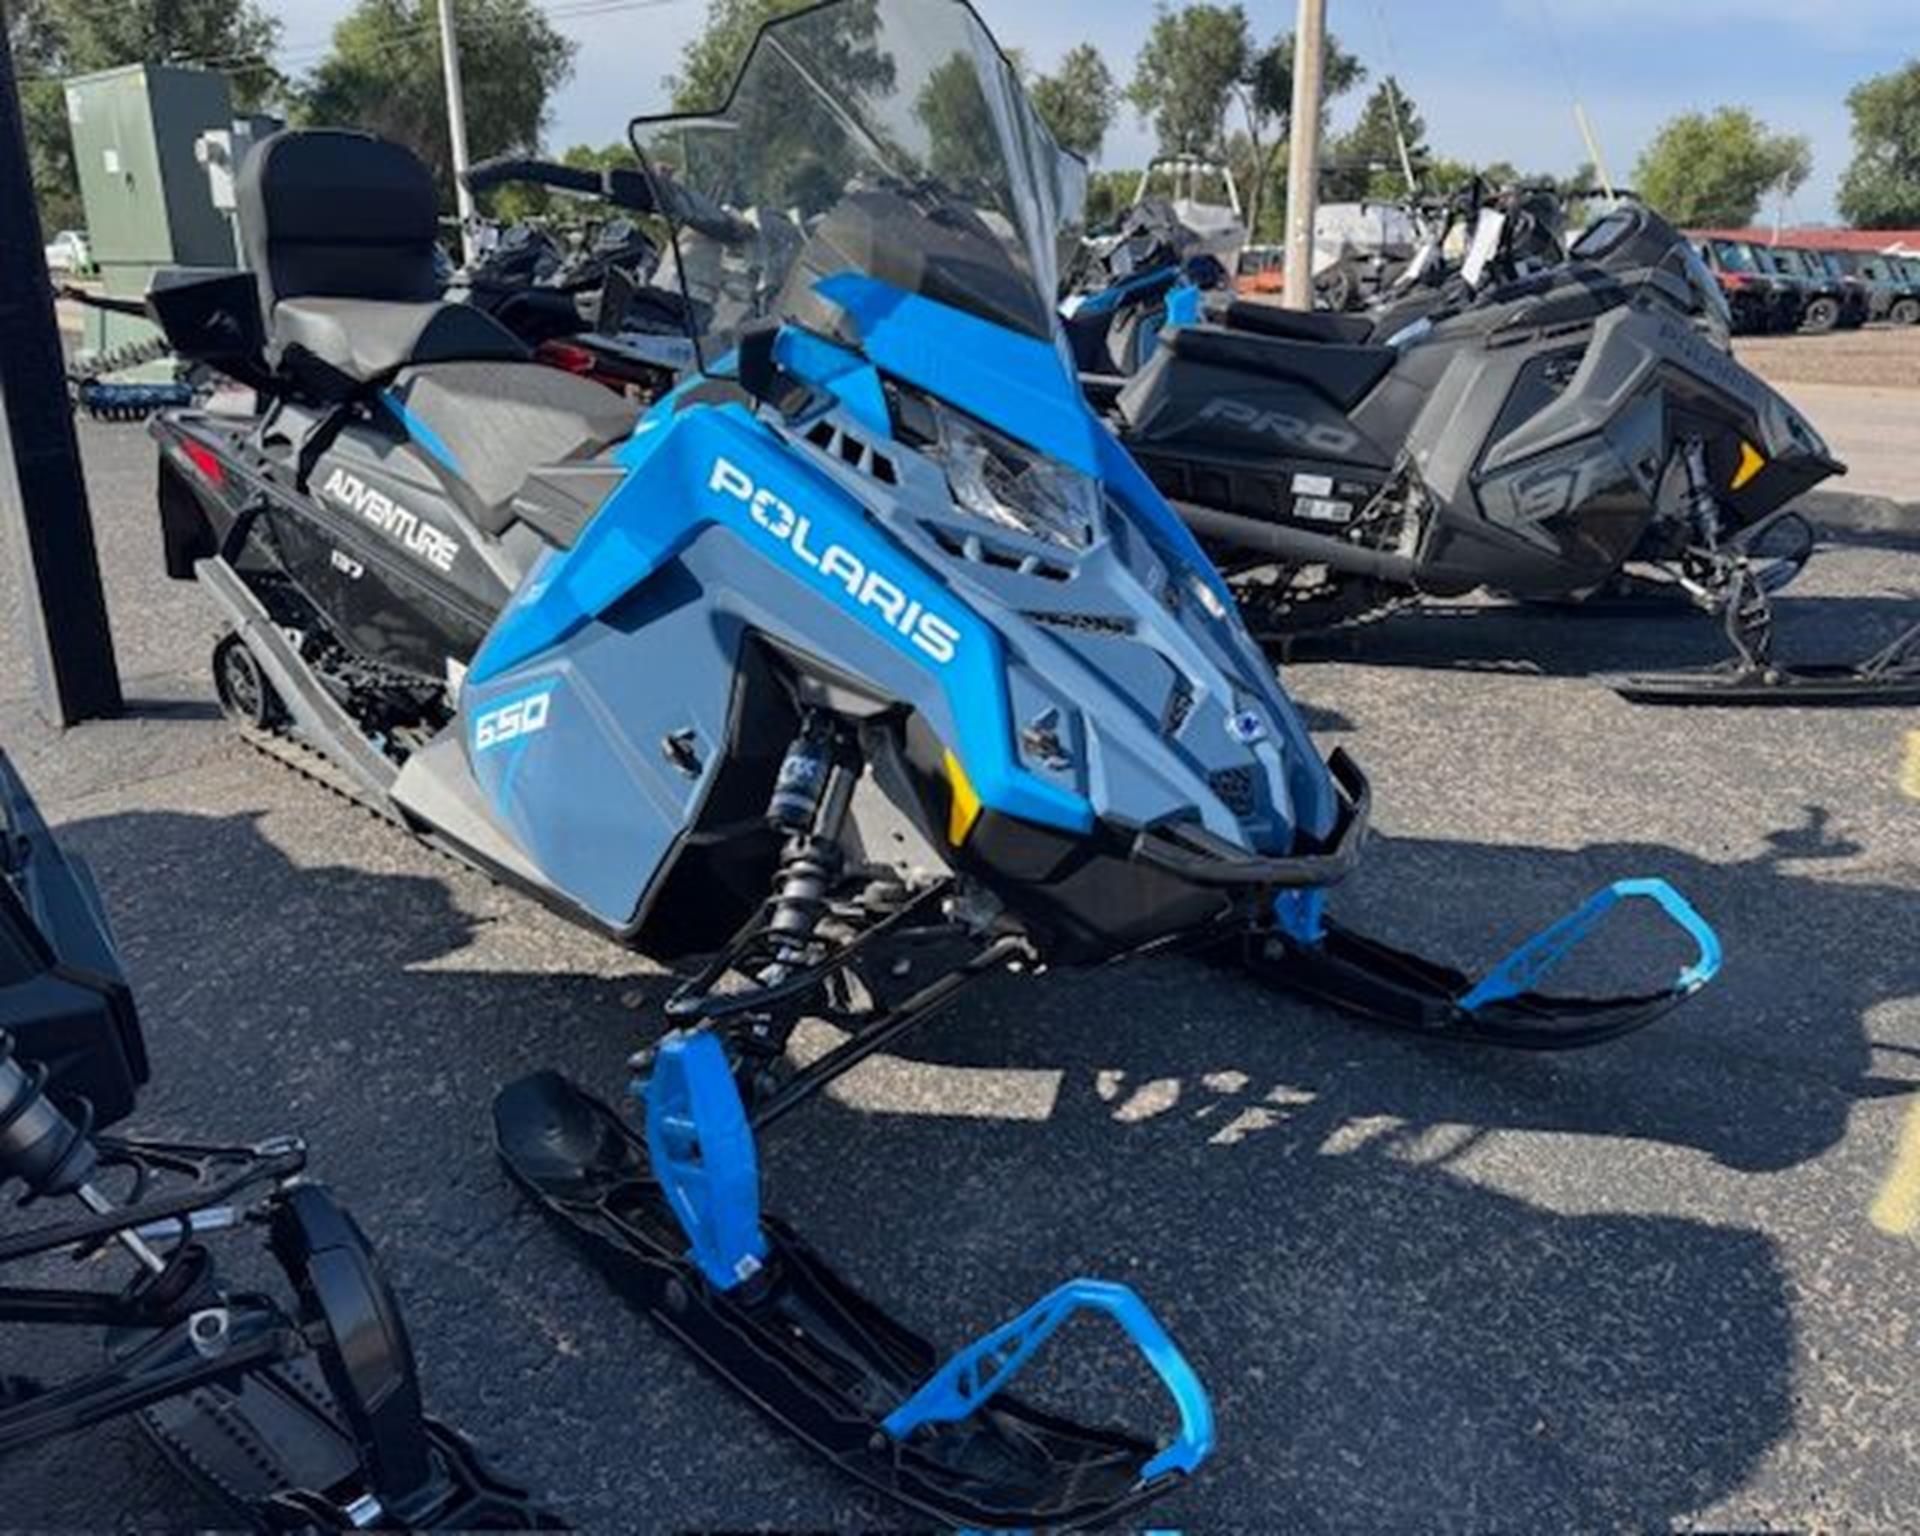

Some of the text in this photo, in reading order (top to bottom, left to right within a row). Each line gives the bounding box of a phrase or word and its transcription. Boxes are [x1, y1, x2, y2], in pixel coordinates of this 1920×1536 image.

[1198, 398, 1359, 453] PRO
[323, 468, 460, 571] ADVENTURE
[708, 456, 960, 664] POLARIS
[475, 691, 549, 751] 650
